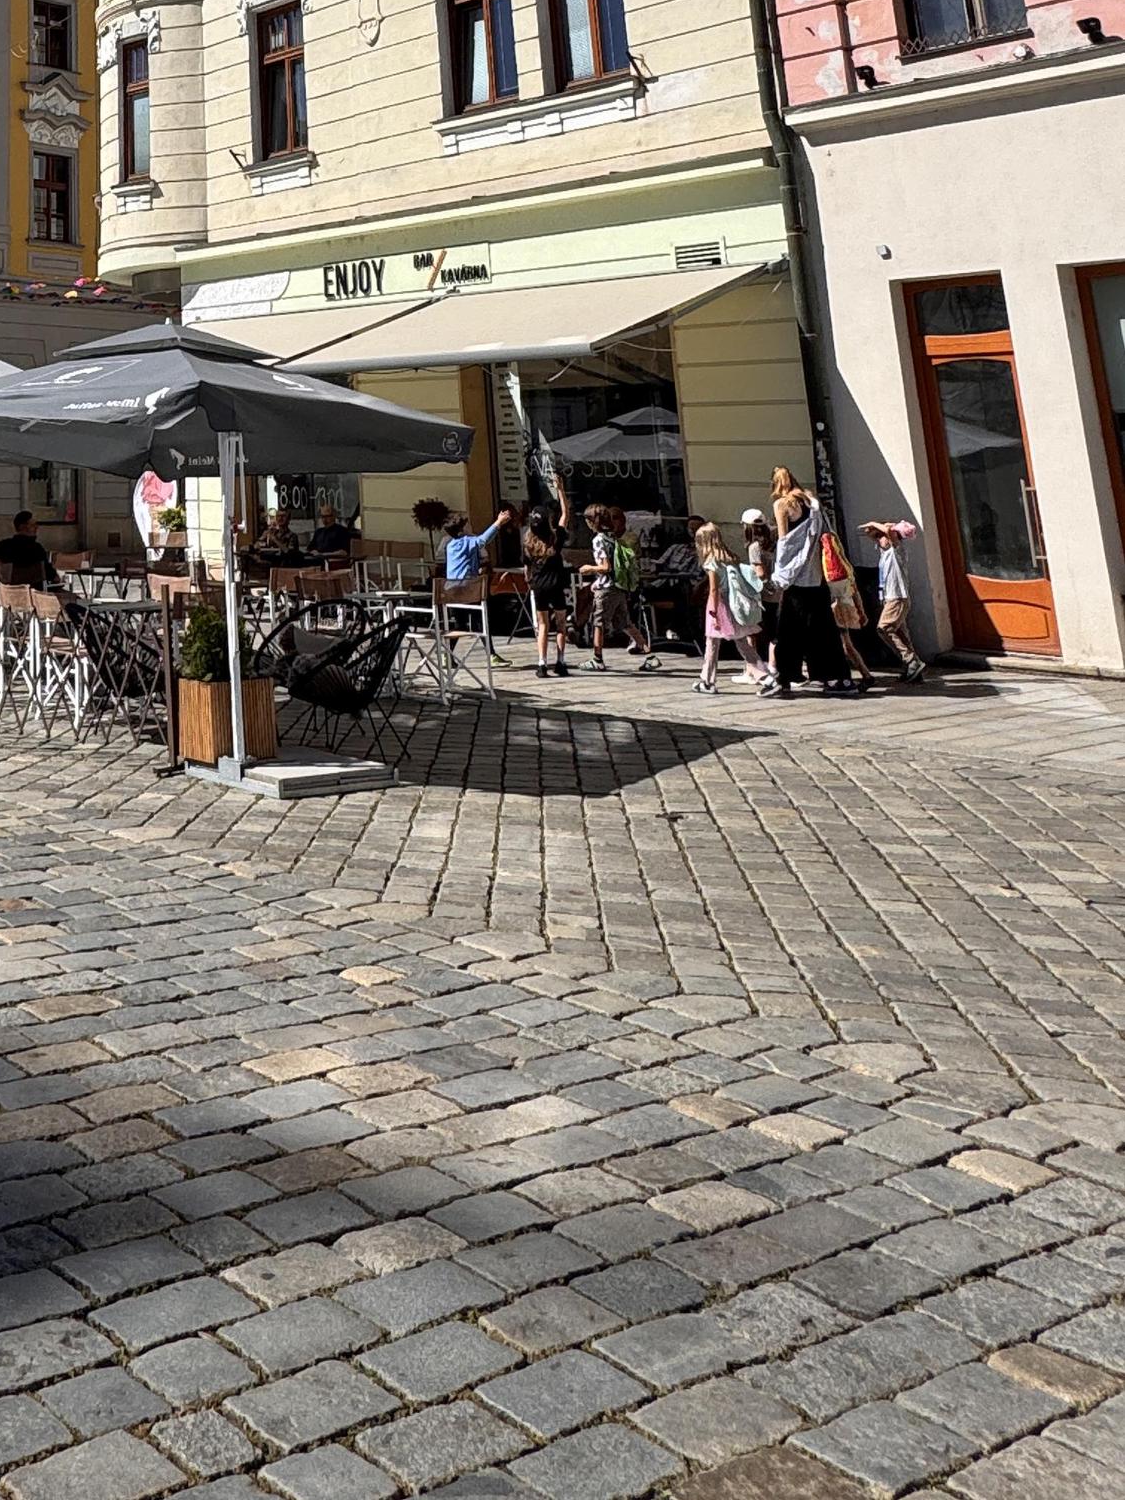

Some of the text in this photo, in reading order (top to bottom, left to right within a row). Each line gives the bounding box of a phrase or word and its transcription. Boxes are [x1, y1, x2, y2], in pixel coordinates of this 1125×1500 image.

[413, 253, 434, 271] BAR
[323, 259, 385, 301] ENJOY
[440, 263, 489, 284] KAVÁRNA
